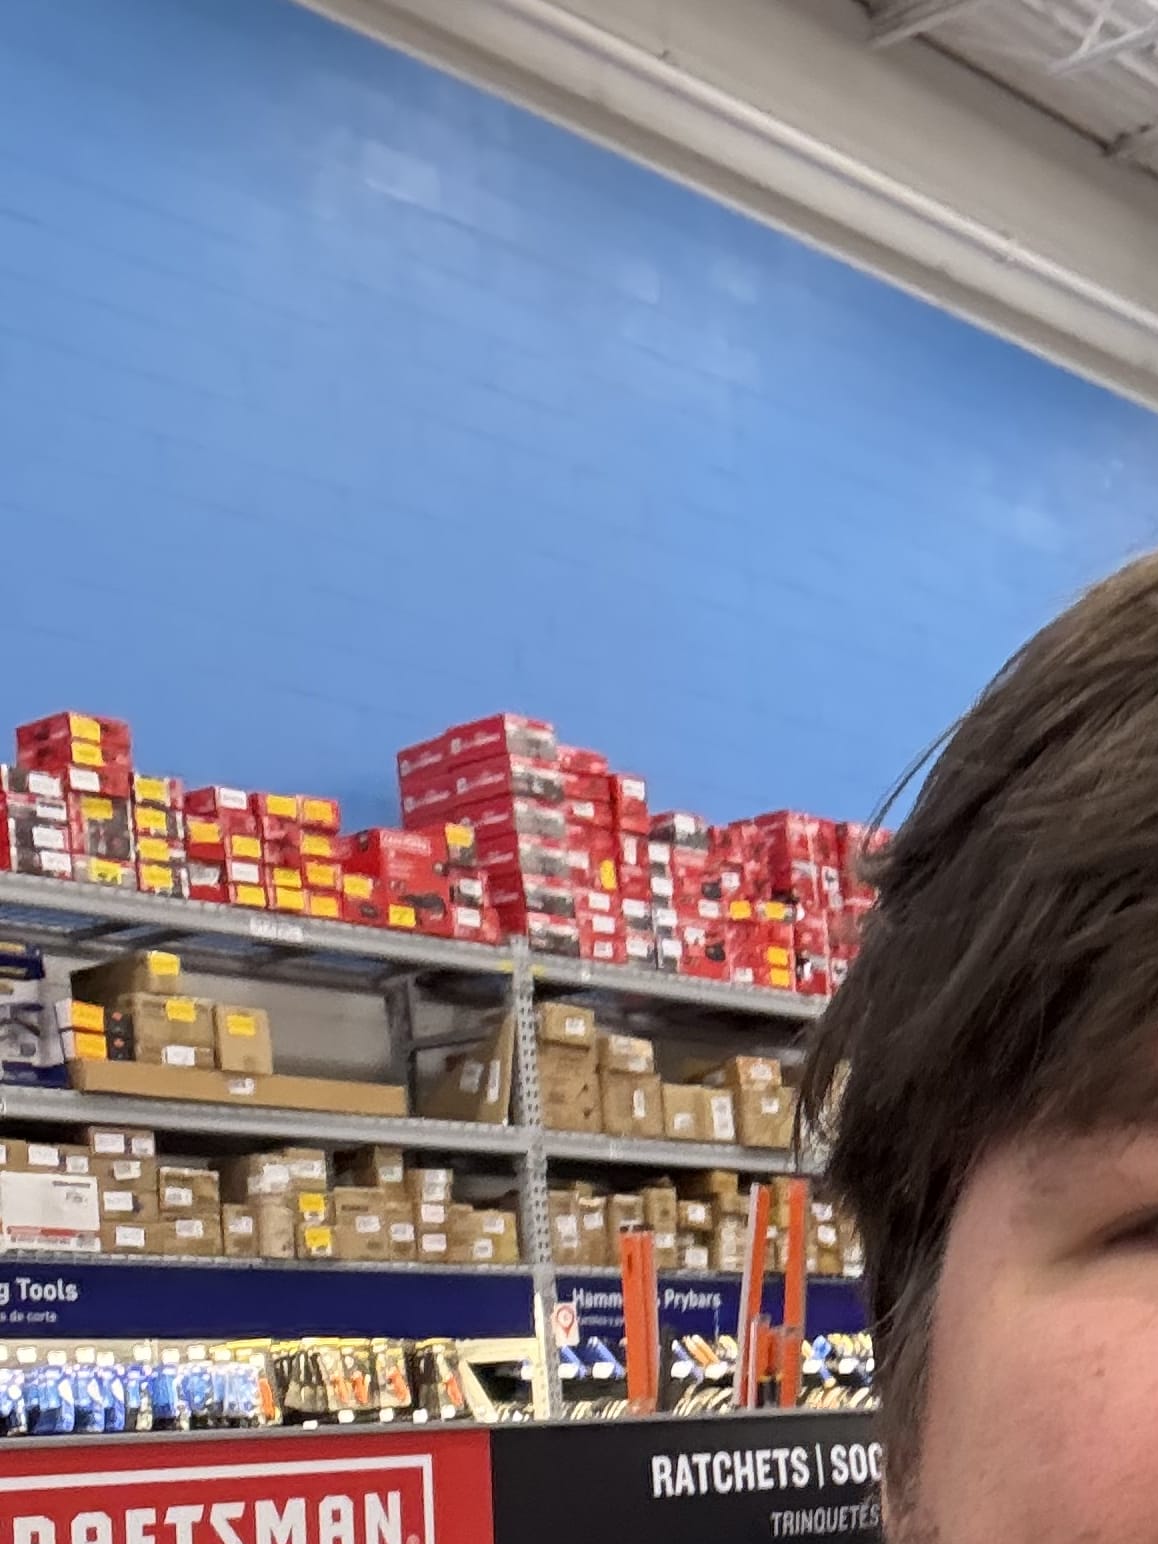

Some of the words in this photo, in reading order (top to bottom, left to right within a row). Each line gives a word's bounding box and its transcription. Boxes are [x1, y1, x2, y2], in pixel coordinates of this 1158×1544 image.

[15, 1276, 79, 1302] Tools
[572, 1287, 624, 1309] Hamm
[664, 1288, 722, 1313] Prybars
[651, 1445, 811, 1499] RATCHETS
[829, 1441, 883, 1486] SOC
